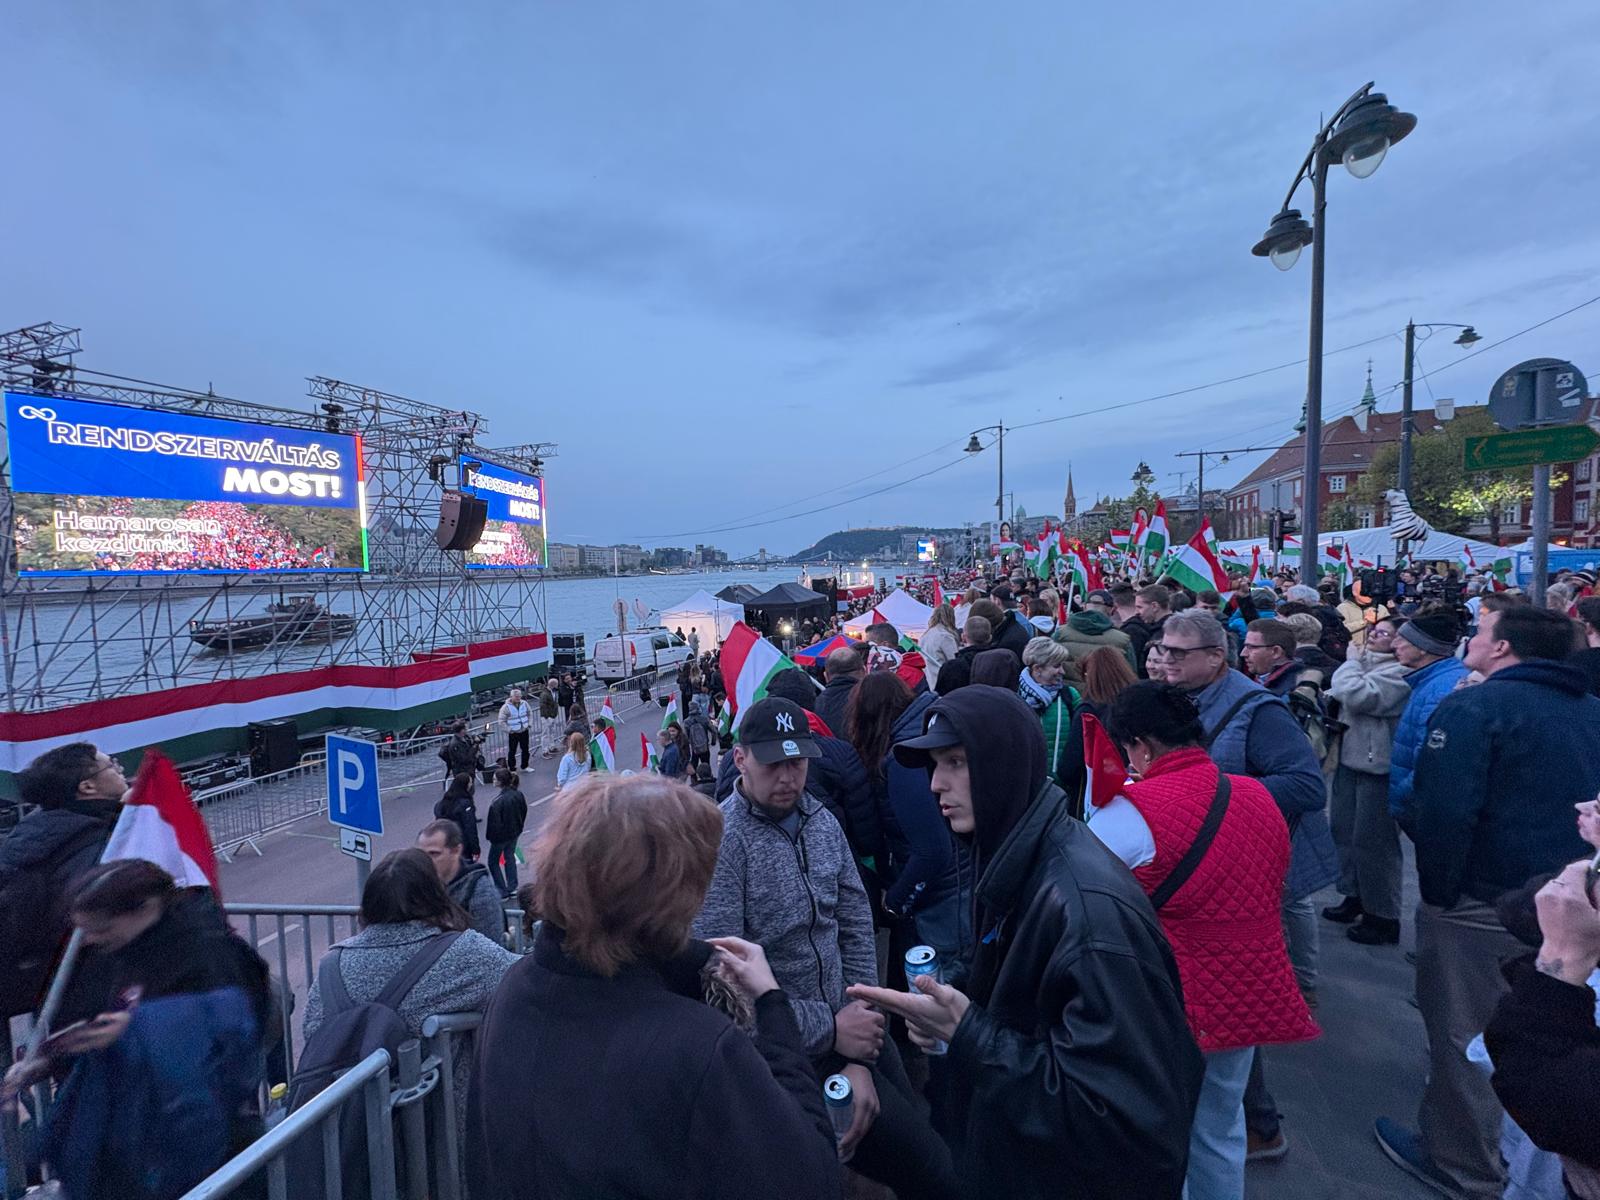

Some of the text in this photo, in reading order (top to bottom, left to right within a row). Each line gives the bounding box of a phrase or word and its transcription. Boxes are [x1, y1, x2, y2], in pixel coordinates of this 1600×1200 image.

[48, 421, 341, 469] RENDSZERVÁLTÁS
[222, 467, 341, 499] MOST!
[54, 511, 220, 534] Hamarosan
[55, 533, 190, 556] kezdünk!
[775, 712, 795, 733] NY
[337, 748, 365, 815] P
